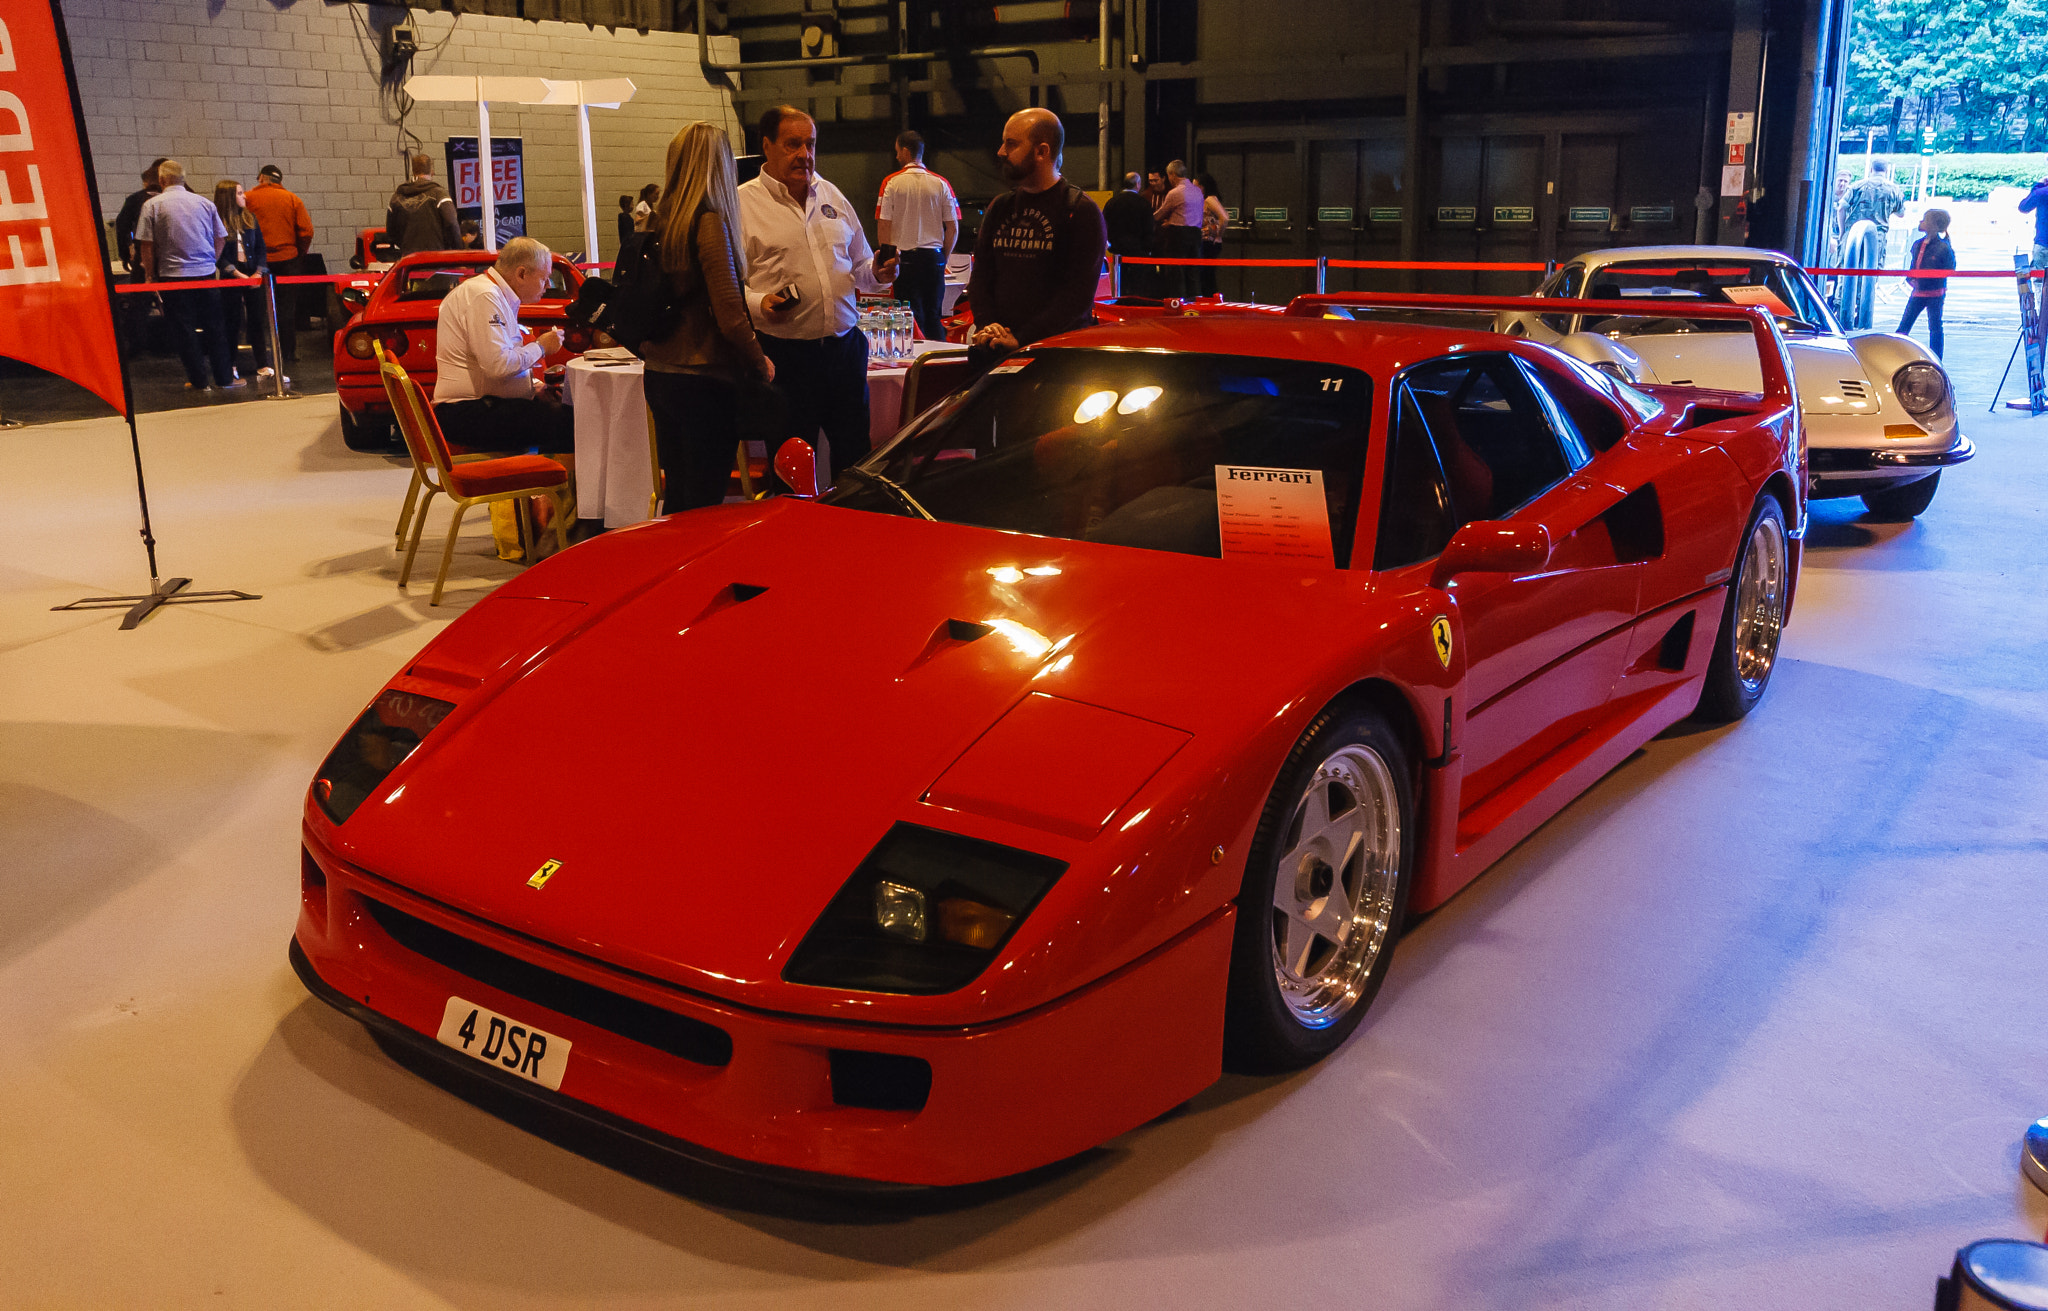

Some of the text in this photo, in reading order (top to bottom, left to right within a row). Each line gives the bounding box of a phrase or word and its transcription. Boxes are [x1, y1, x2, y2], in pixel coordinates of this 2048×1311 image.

[461, 183, 517, 204] DVE
[1320, 378, 1343, 392] 11
[1227, 467, 1312, 485] Ferrari
[458, 1009, 548, 1079] 4 DSR
